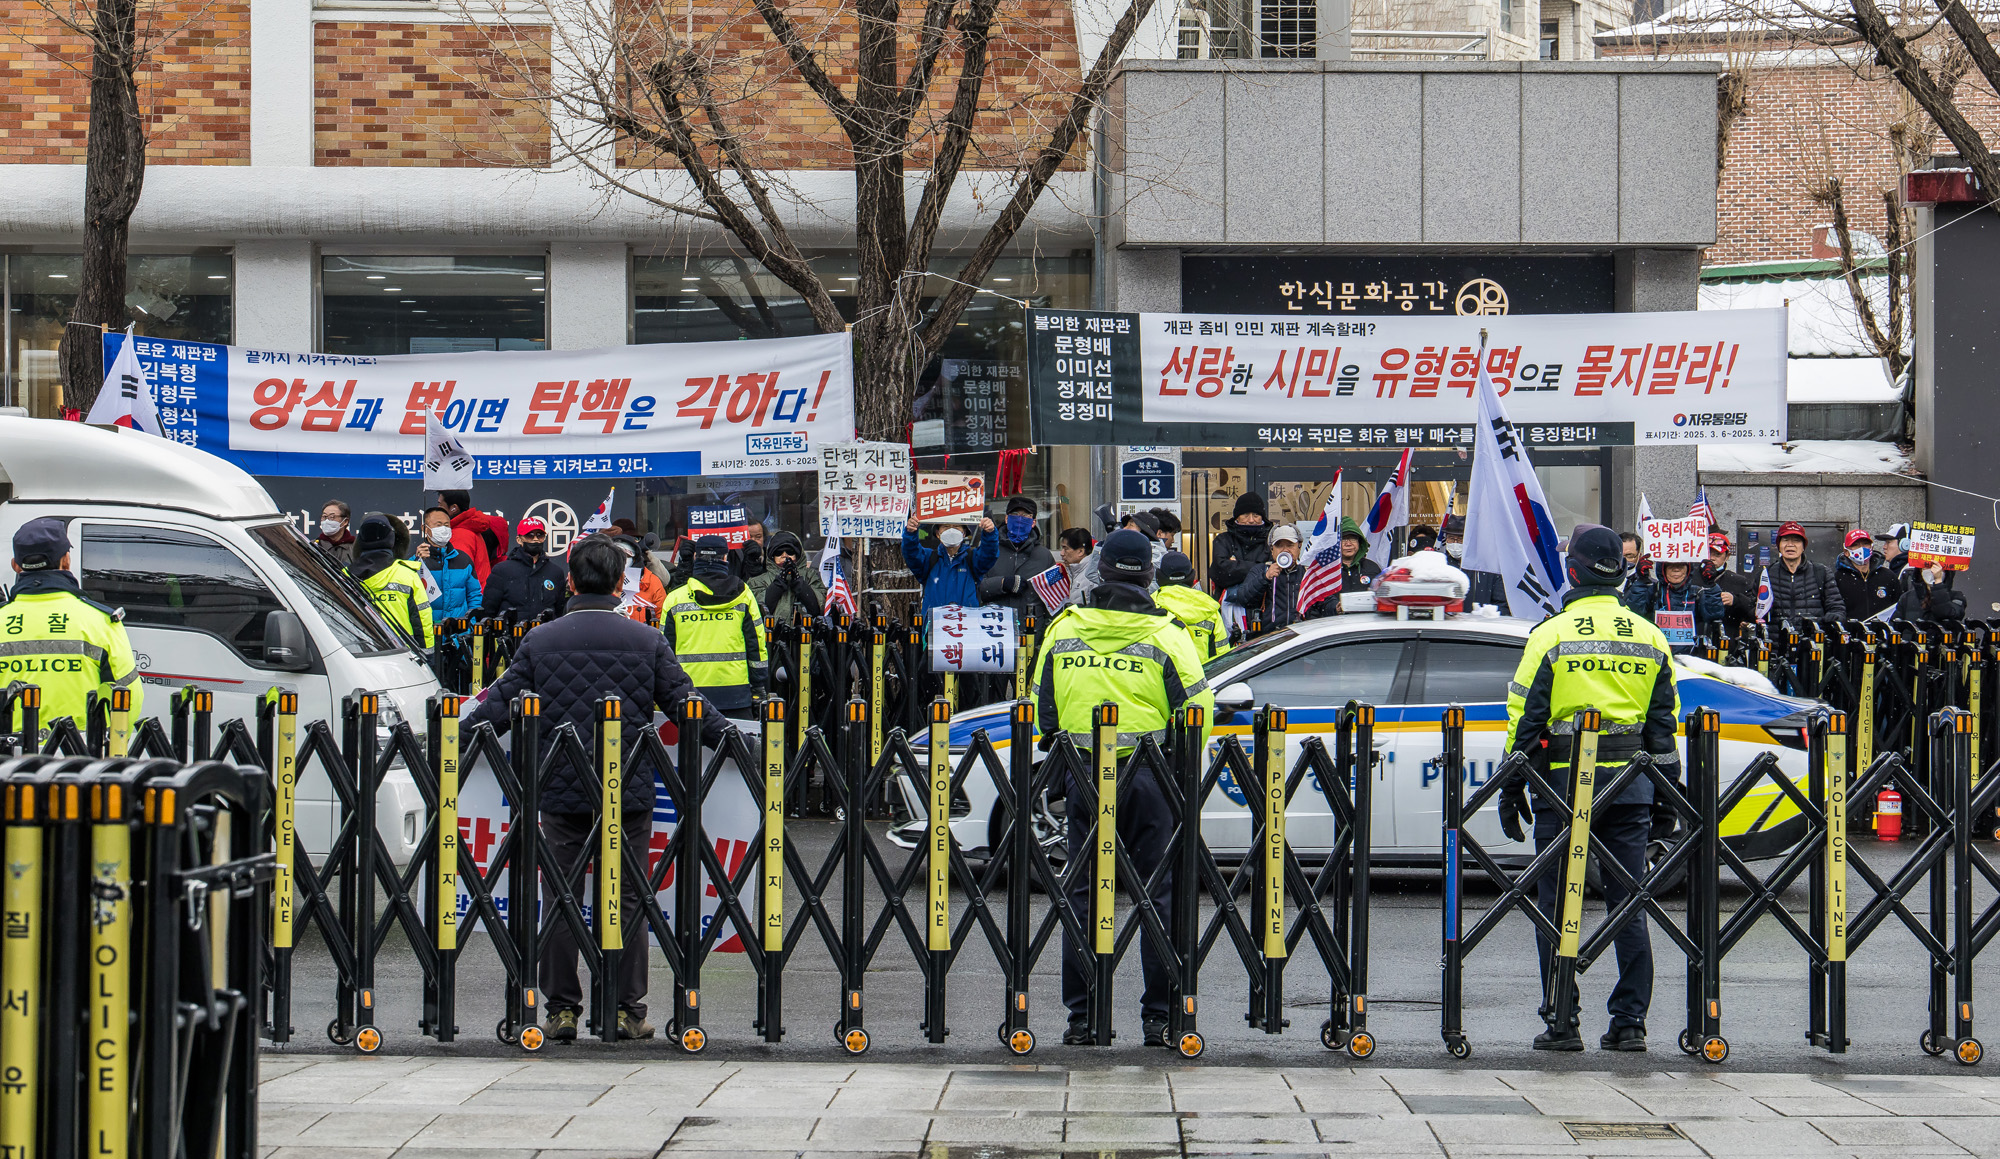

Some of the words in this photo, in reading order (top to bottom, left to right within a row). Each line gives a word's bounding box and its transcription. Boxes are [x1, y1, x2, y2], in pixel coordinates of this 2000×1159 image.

[1279, 281, 1449, 311] 한식문화공간
[1034, 315, 1080, 331] 불의한
[1085, 317, 1130, 334] 재판관
[1164, 320, 1193, 336] 개판
[1199, 320, 1228, 336] 좀비
[1235, 320, 1264, 336] 인민
[1270, 320, 1300, 336] 재판
[1306, 320, 1376, 337] 계속할래?
[172, 345, 217, 361] 재판관
[1054, 335, 1111, 356] 문형배
[246, 350, 290, 364] 끝까지
[297, 353, 377, 366] 지켜주시오!
[1056, 358, 1112, 378] 이미선
[141, 361, 197, 383] 김복형
[1158, 345, 1253, 398] 선량한
[1263, 346, 1360, 398] 시민을
[1372, 345, 1563, 398] 유혈혁명으로
[1574, 340, 1739, 396] 몰지말라!
[1057, 380, 1113, 400] 정계선
[249, 378, 385, 433] 양심과
[399, 379, 510, 434] 법이면
[522, 378, 656, 434] 탄핵은
[676, 370, 831, 430] 각하다!
[1058, 402, 1114, 421] 정정미
[161, 407, 198, 426] 형식
[1688, 412, 1748, 426] 자유통일당
[751, 436, 803, 450] 자유민주당
[1257, 428, 1302, 443] 역사와
[1307, 428, 1352, 444] 국민은
[1358, 427, 1388, 443] 회유
[1394, 428, 1423, 444] 협박
[1430, 428, 1474, 443] 매수를
[1530, 426, 1597, 442] 응징한다!
[1645, 430, 1680, 440] 표시기간:
[1683, 430, 1707, 439] 2025.
[1710, 430, 1719, 439] 3.
[1721, 430, 1754, 439] 6~2025.
[1757, 429, 1767, 438] 3.
[1770, 429, 1780, 438] 21
[488, 459, 547, 475] 당신들을
[553, 458, 613, 473] 지켜보고
[618, 457, 653, 474] 있다.
[711, 459, 747, 470] 표시기간:
[749, 458, 772, 468] 2025.
[775, 458, 784, 467] 3.
[823, 447, 858, 469] 탄핵
[1138, 461, 1159, 470] 북촌로
[824, 471, 858, 491] 무효
[864, 473, 907, 493] 우리법
[1138, 478, 1161, 495] 18
[823, 494, 863, 514] 카르텔
[866, 496, 909, 514] 사퇴해
[919, 487, 983, 517] 탄핵각하
[690, 508, 746, 525] 헌법대로!
[681, 612, 734, 623] POLICE
[0, 659, 82, 674] POLICE
[1062, 655, 1144, 673] POLICE
[1566, 659, 1647, 675] POLICE
[1864, 686, 1872, 734] POLICE
[282, 756, 292, 846] POLICE
[608, 761, 619, 850] POLICE
[935, 763, 947, 851] POLICE
[1271, 771, 1282, 859] POLICE
[1832, 775, 1843, 863] POLICE
[443, 759, 457, 925] 질서유지선
[768, 763, 783, 928] 질서유지선
[1100, 766, 1116, 930] 질서유지선
[1564, 771, 1593, 934] 질서유지선
[281, 866, 291, 923] LINE
[609, 867, 618, 926] LINE
[936, 869, 945, 927] LINE
[1272, 877, 1281, 934] LINE
[1833, 880, 1843, 938] LINE
[95, 909, 118, 1092] POLICE
